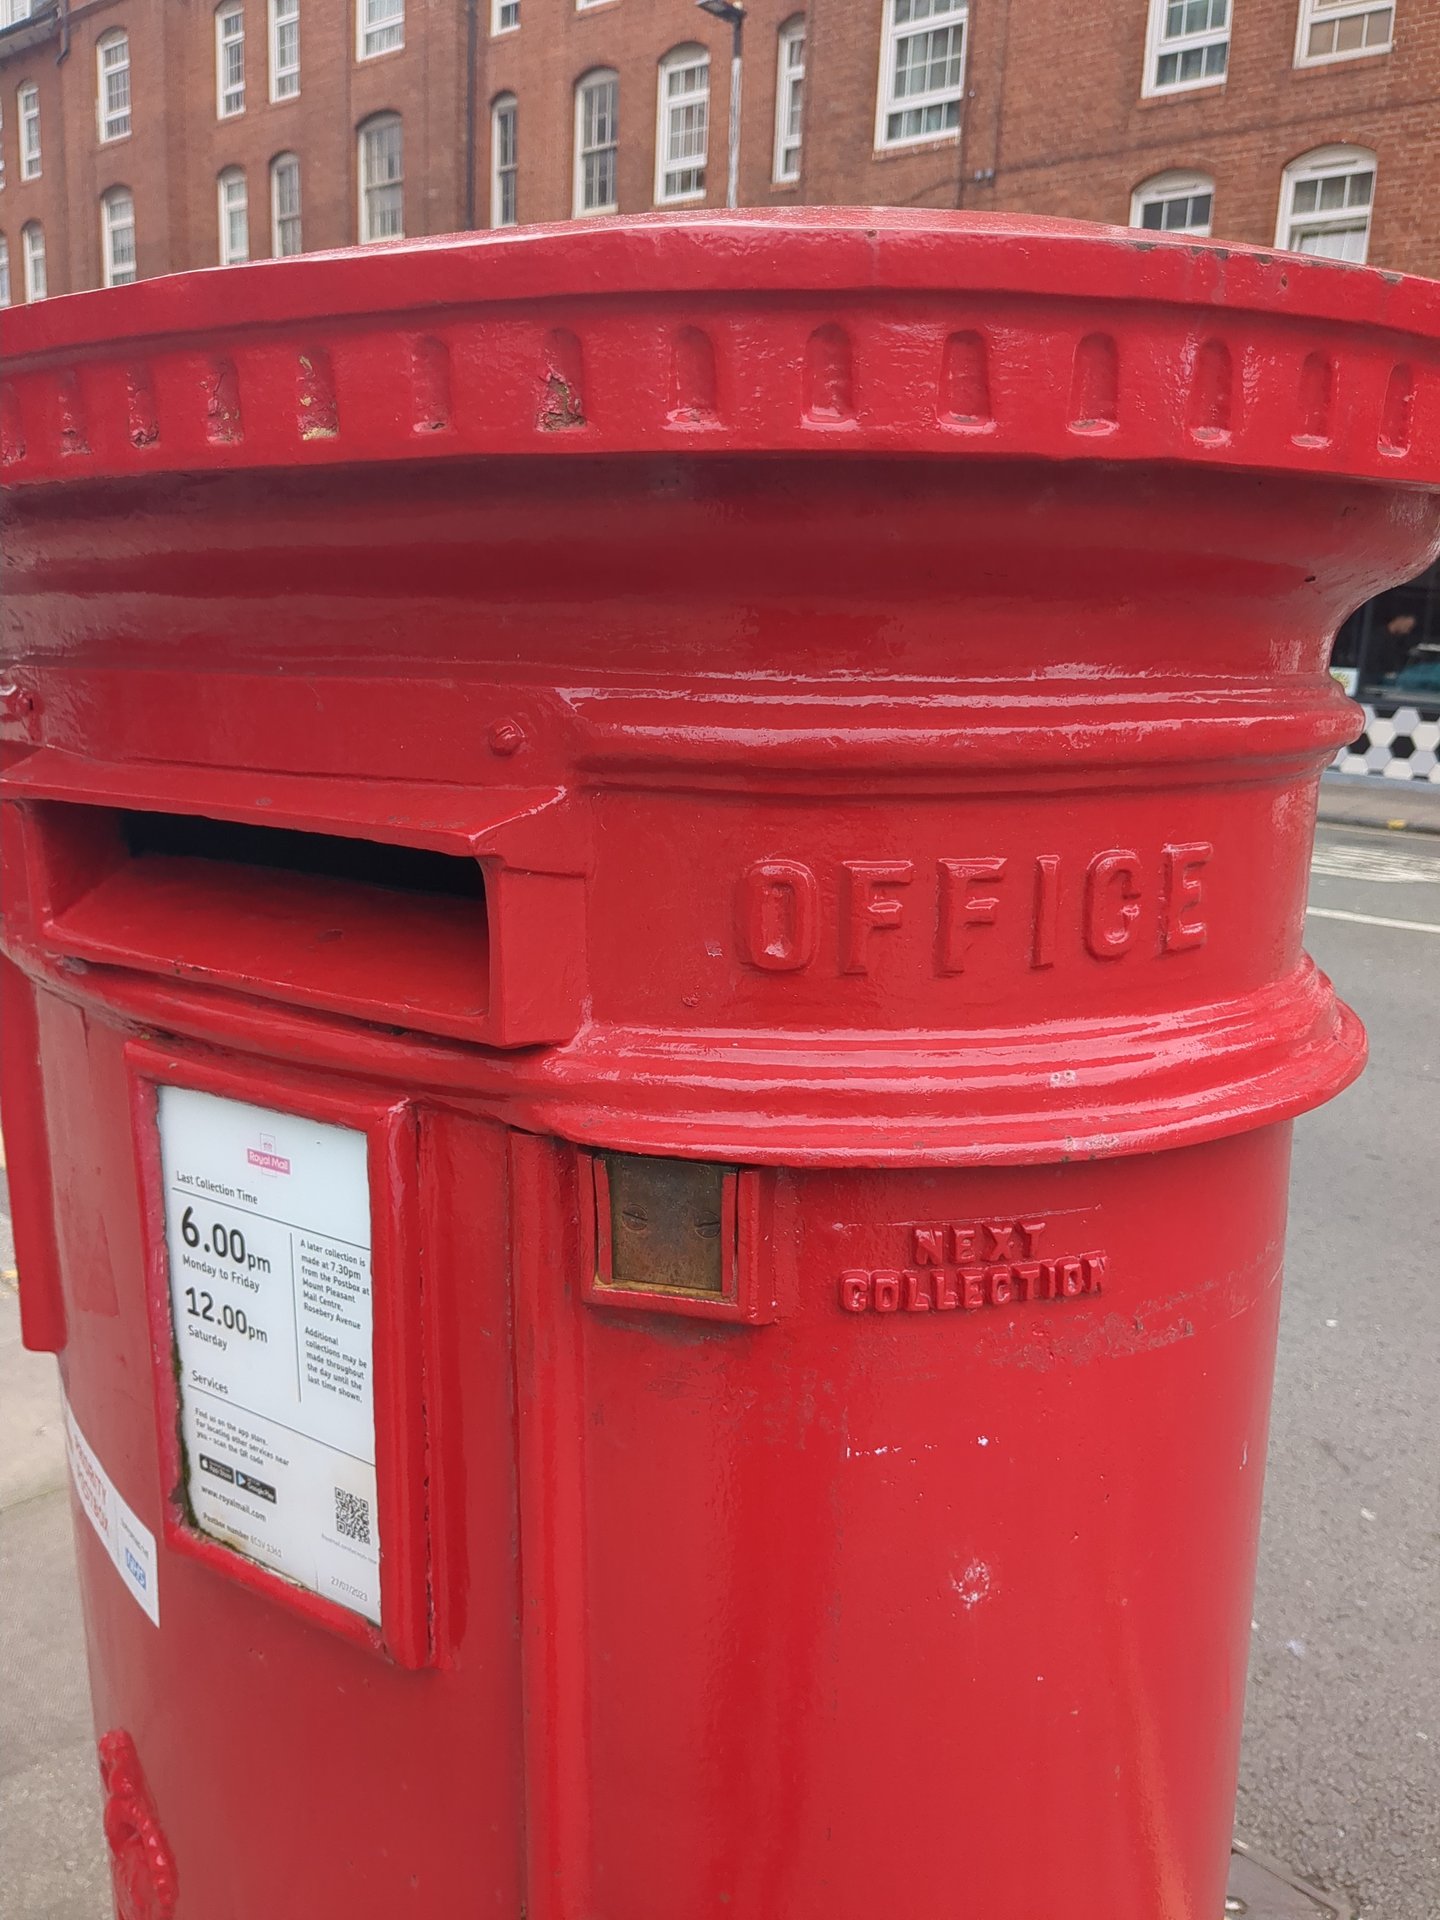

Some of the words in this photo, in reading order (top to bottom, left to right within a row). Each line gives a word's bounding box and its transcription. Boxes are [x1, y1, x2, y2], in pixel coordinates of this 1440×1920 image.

[736, 841, 1213, 976] OFFICE
[249, 1151, 270, 1167] Royal
[271, 1157, 289, 1170] Mail
[176, 1170, 194, 1185] Last
[196, 1176, 235, 1197] Collection
[237, 1188, 258, 1204] Time
[182, 1206, 271, 1273] 6.00pm
[300, 1239, 306, 1248] A
[307, 1241, 323, 1253] later
[325, 1248, 358, 1264] collection
[359, 1257, 366, 1267] is
[911, 1222, 1046, 1265] NEXT
[183, 1254, 216, 1277] Monday
[219, 1268, 229, 1280] to
[231, 1271, 260, 1293] Friday
[301, 1255, 320, 1266] made
[321, 1261, 329, 1270] at
[330, 1261, 361, 1280] 7.30pm
[302, 1265, 318, 1278] from
[320, 1272, 331, 1283] the
[333, 1276, 360, 1292] Postbox
[362, 1287, 370, 1296] at
[838, 1249, 1110, 1313] COLLECTION
[302, 1278, 324, 1292] Mount
[326, 1285, 356, 1303] Pleasant
[303, 1290, 317, 1301] Mail
[185, 1286, 268, 1343] 12.00pm
[304, 1302, 334, 1321] Rosebery
[336, 1314, 361, 1330] Avenue
[188, 1324, 228, 1351] Saturday
[305, 1326, 338, 1345] Additional
[305, 1340, 341, 1358] collections
[342, 1354, 356, 1365] may
[358, 1358, 367, 1368] be
[306, 1352, 324, 1364] made
[326, 1359, 364, 1380] throughout
[192, 1370, 229, 1394] Services
[307, 1363, 318, 1373] the
[320, 1368, 331, 1379] day
[333, 1374, 349, 1385] until
[350, 1380, 362, 1390] the
[308, 1374, 320, 1385] last
[322, 1380, 337, 1392] time
[201, 1486, 267, 1522] www.royalmail.com
